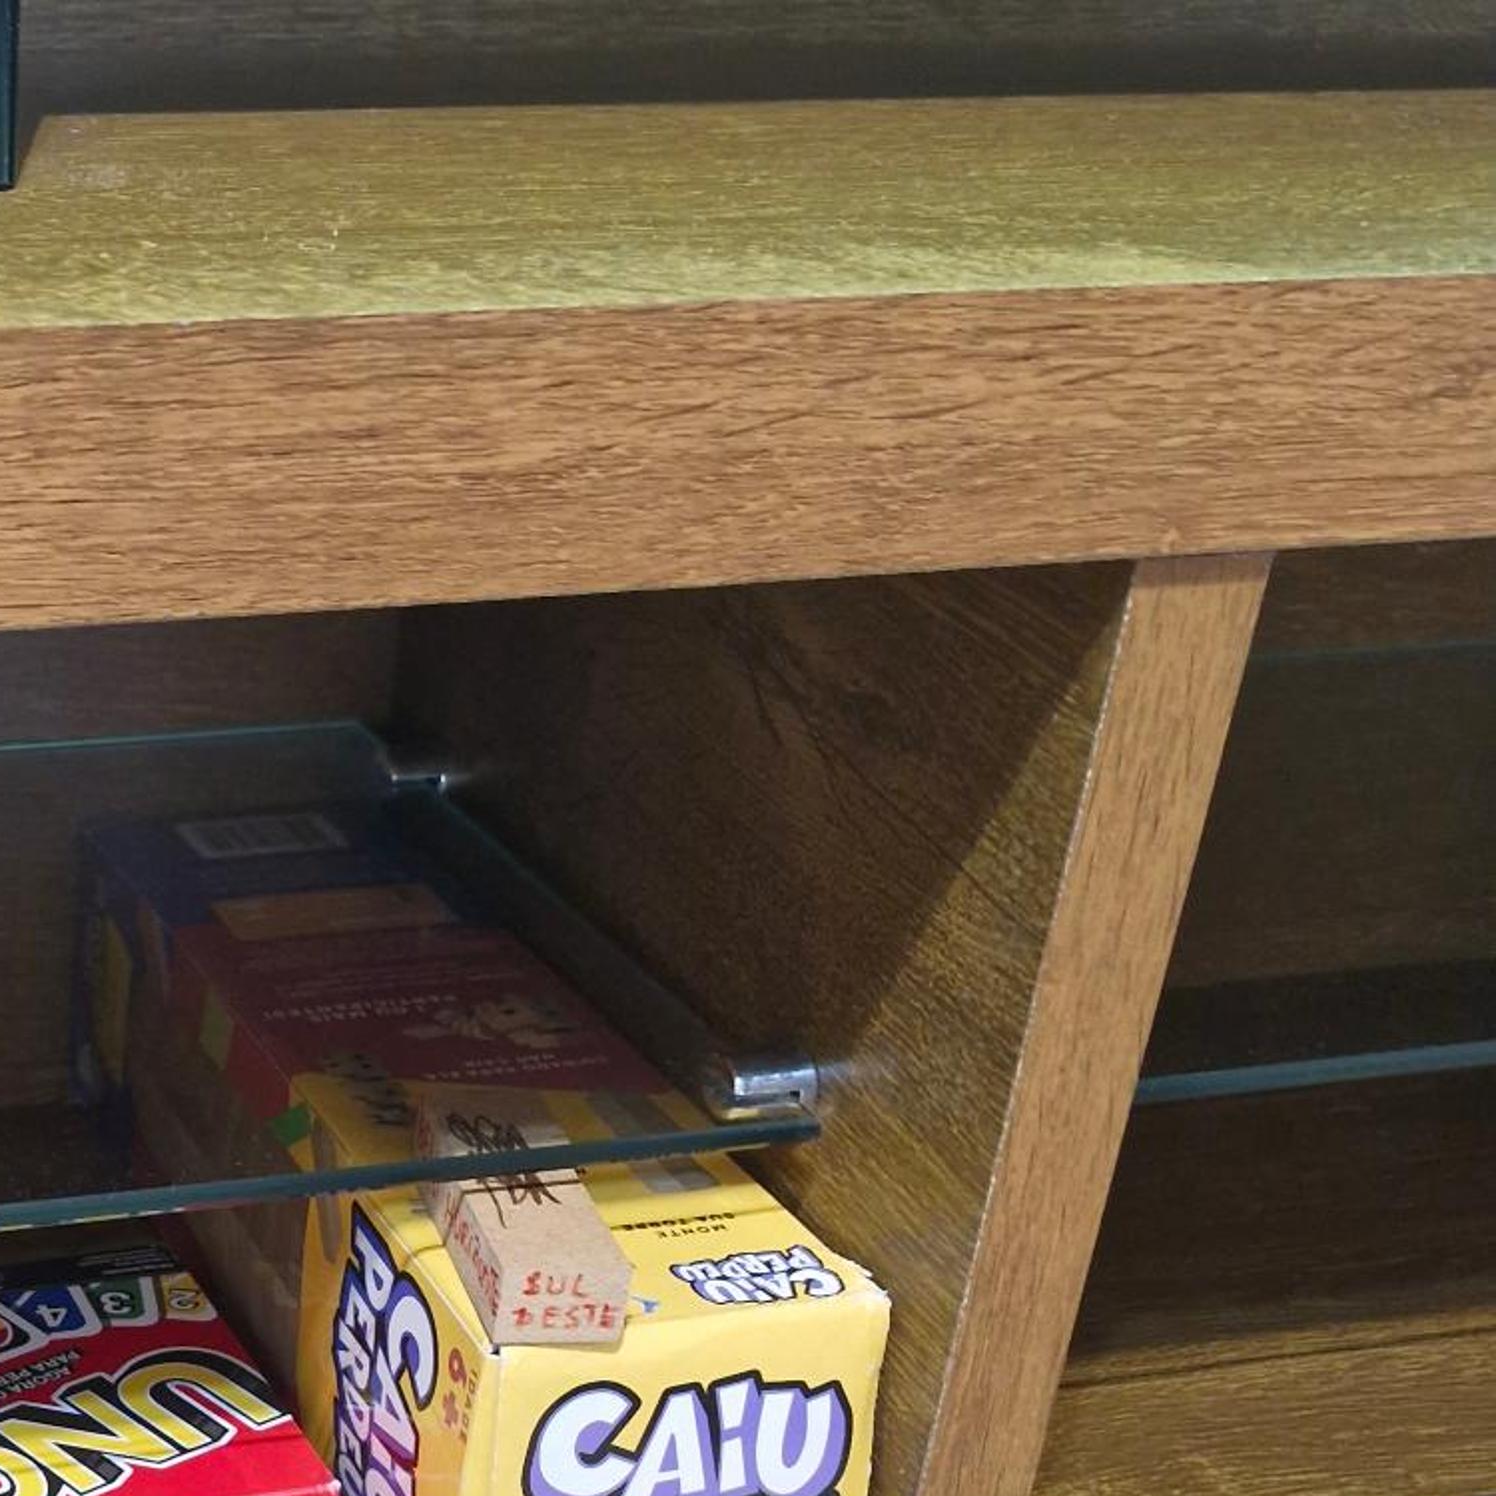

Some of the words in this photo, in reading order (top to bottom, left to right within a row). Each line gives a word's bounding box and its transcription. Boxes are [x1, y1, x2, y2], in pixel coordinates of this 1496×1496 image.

[658, 1223, 728, 1239] MONTE
[670, 1245, 824, 1282] PERDEU
[691, 1268, 846, 1304] CAIU
[102, 1288, 132, 1315] 3
[35, 1302, 64, 1330] 4
[30, 1350, 81, 1377] PARA
[10, 1366, 73, 1394] AGORA
